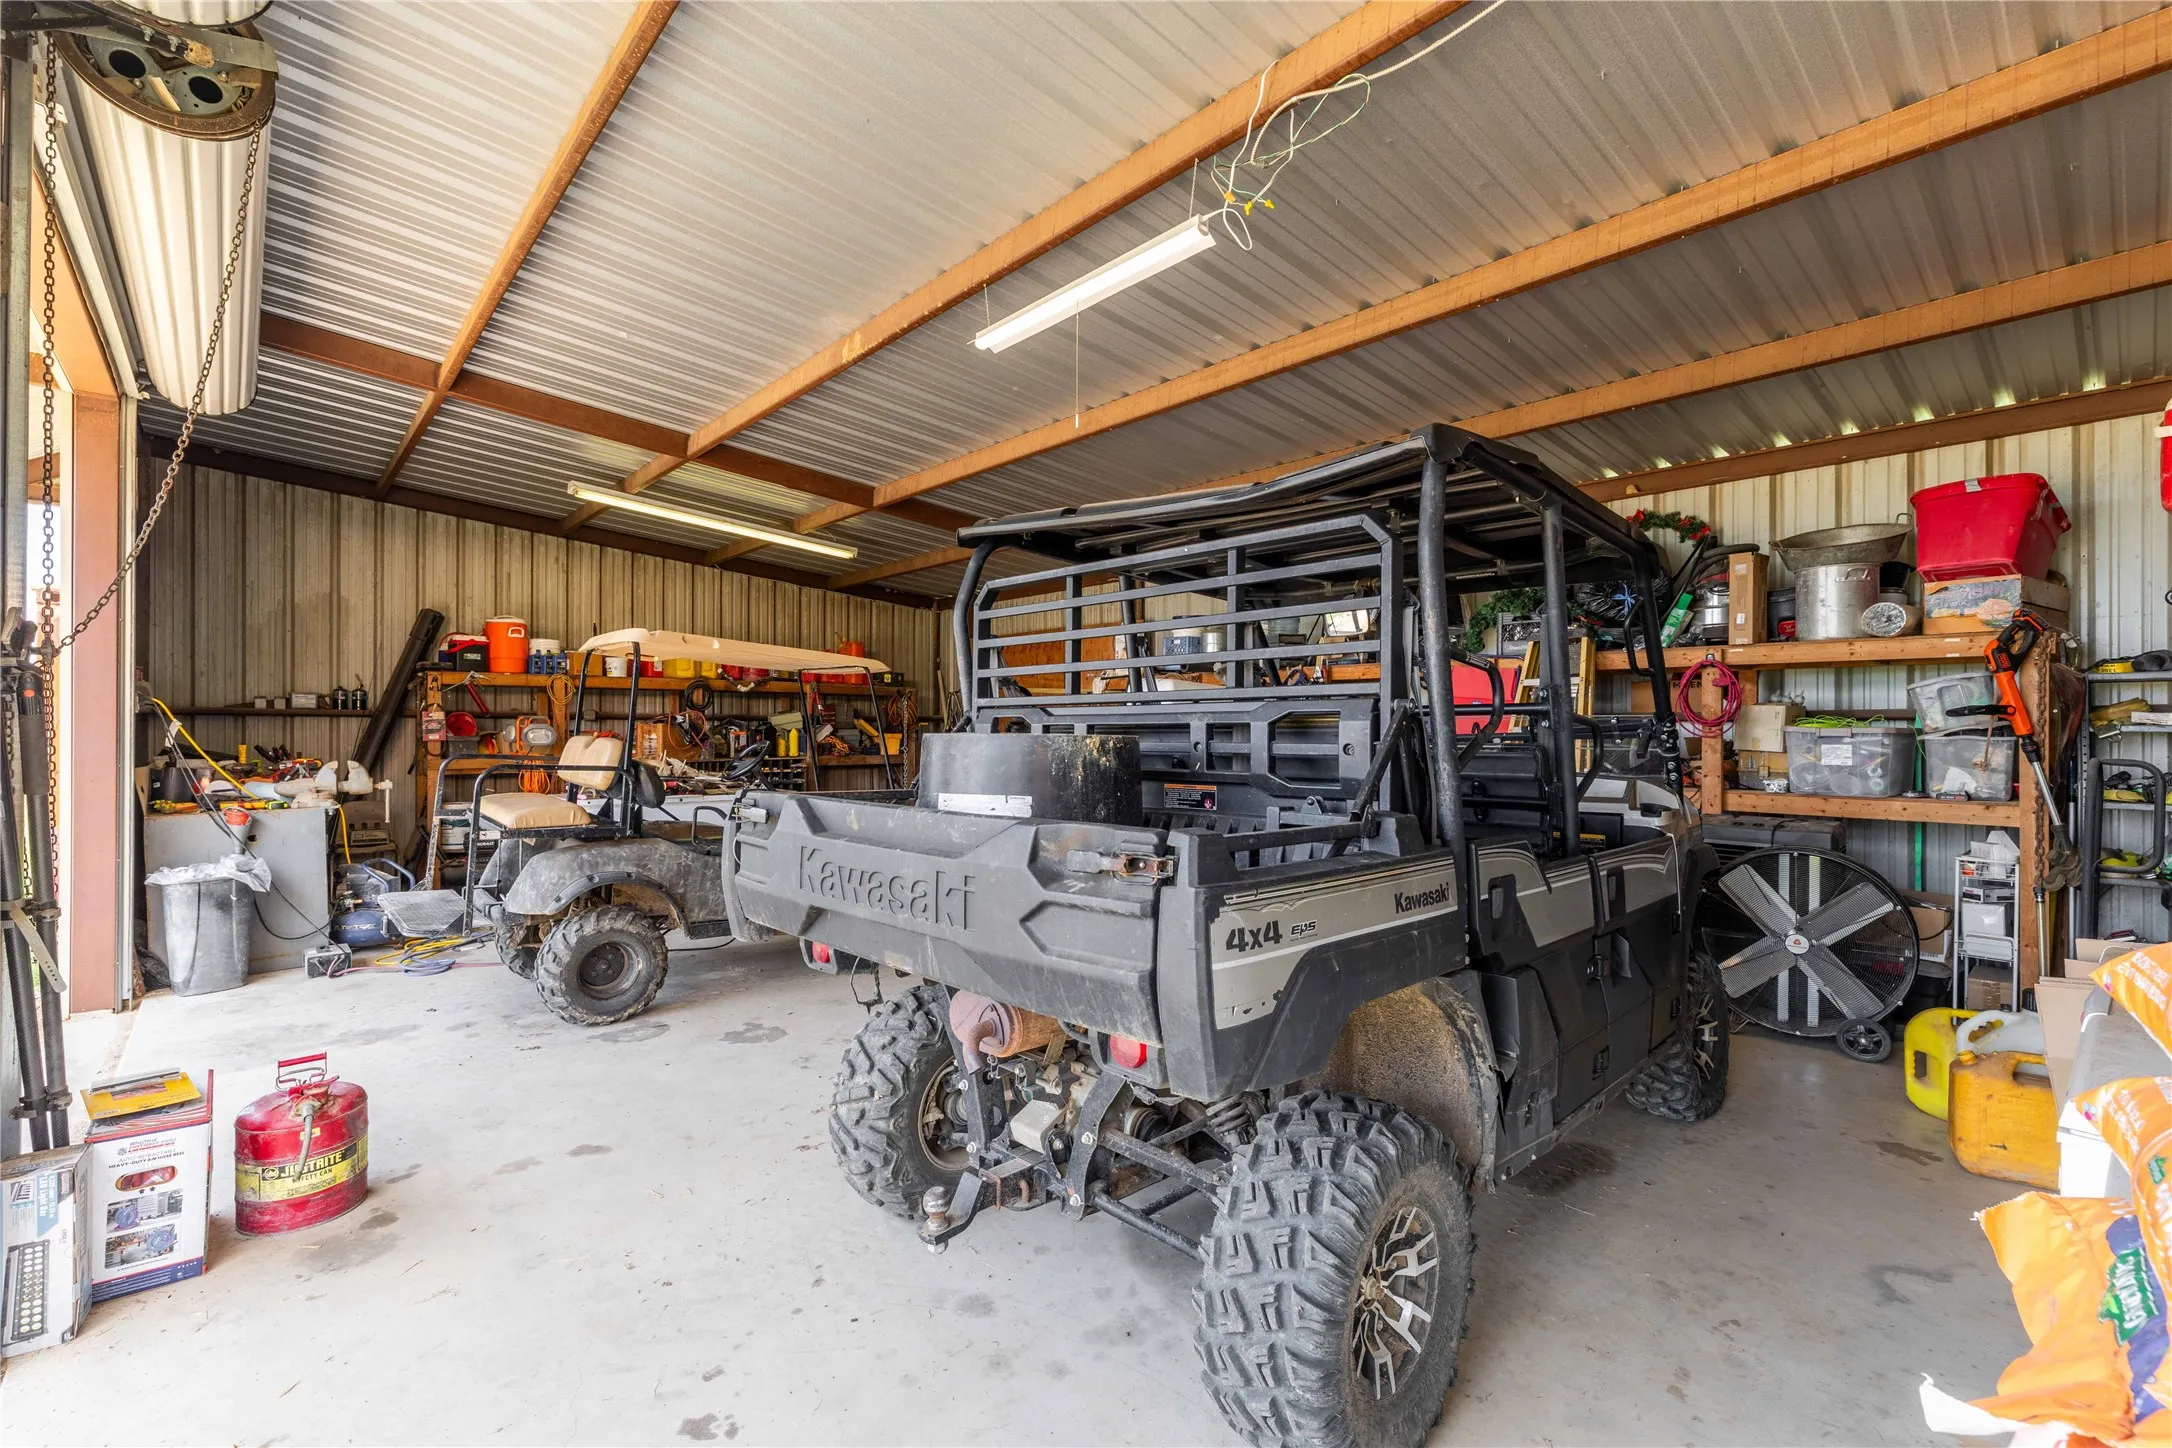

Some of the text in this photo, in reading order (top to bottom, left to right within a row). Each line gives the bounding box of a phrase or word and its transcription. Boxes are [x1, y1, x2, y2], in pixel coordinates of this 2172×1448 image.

[800, 846, 976, 932] Kawasaki
[1394, 882, 1450, 914] Kawasaki
[1225, 920, 1283, 953] 4x4
[320, 1168, 333, 1176] CAN
[38, 1176, 48, 1217] LED Light Bar
